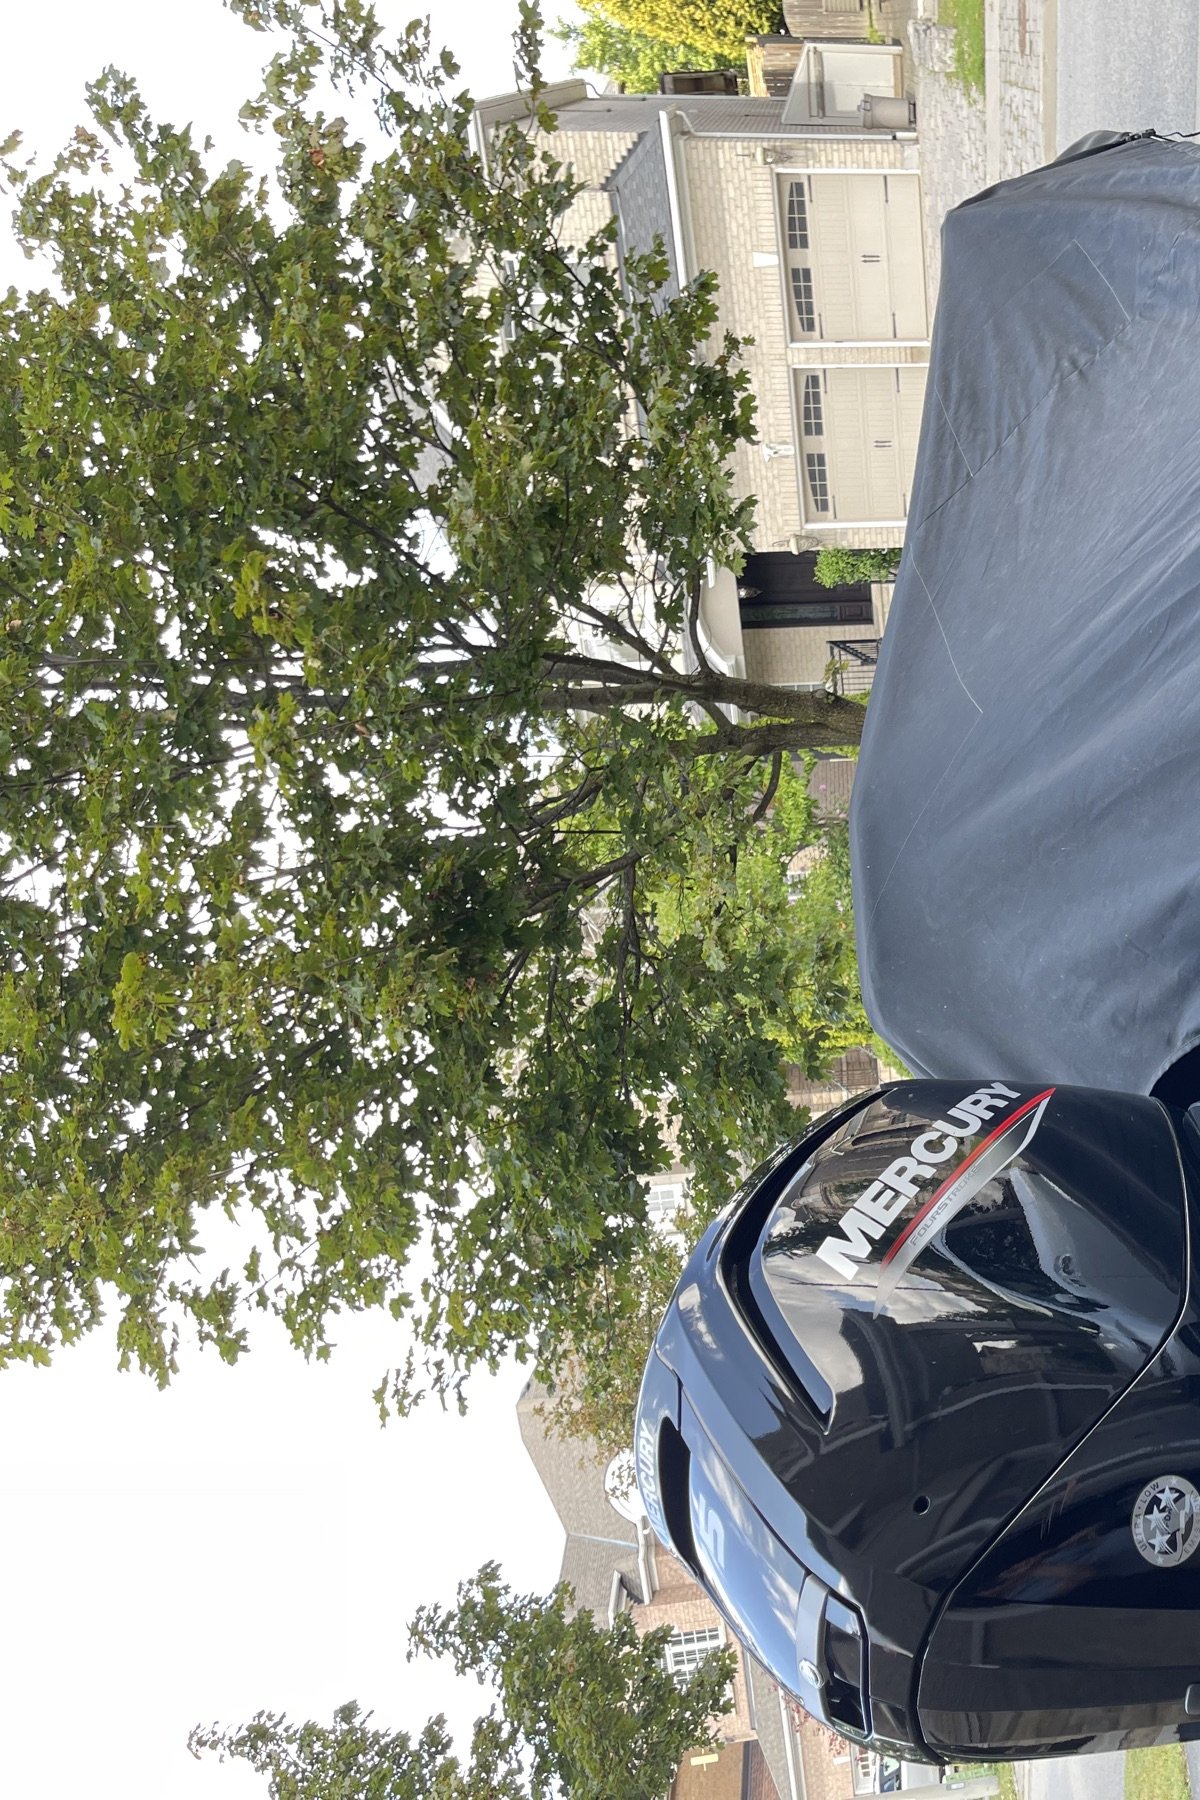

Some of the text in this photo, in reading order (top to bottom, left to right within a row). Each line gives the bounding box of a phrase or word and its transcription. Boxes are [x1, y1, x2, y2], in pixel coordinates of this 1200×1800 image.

[815, 1081, 1024, 1281] MERCURY
[639, 1420, 667, 1538] MERCURY
[1134, 1482, 1159, 1552] ULTRA LOW
